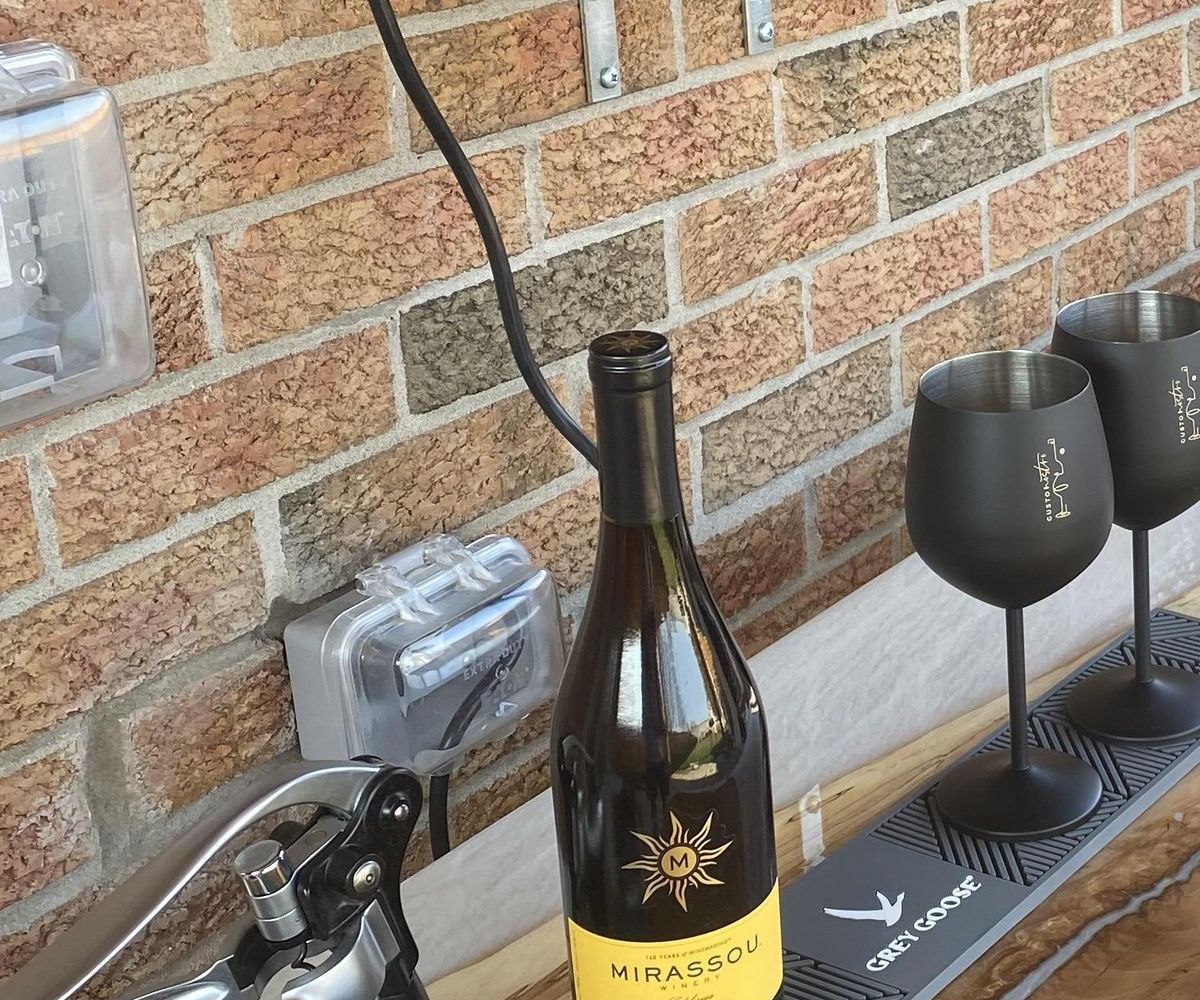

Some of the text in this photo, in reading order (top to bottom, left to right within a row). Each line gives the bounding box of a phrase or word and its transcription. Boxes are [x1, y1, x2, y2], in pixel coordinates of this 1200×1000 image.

[669, 852, 689, 871] M
[866, 874, 982, 972] GREY GOOSE
[611, 934, 758, 983] MIRASSOU
[660, 974, 721, 991] WINERY
